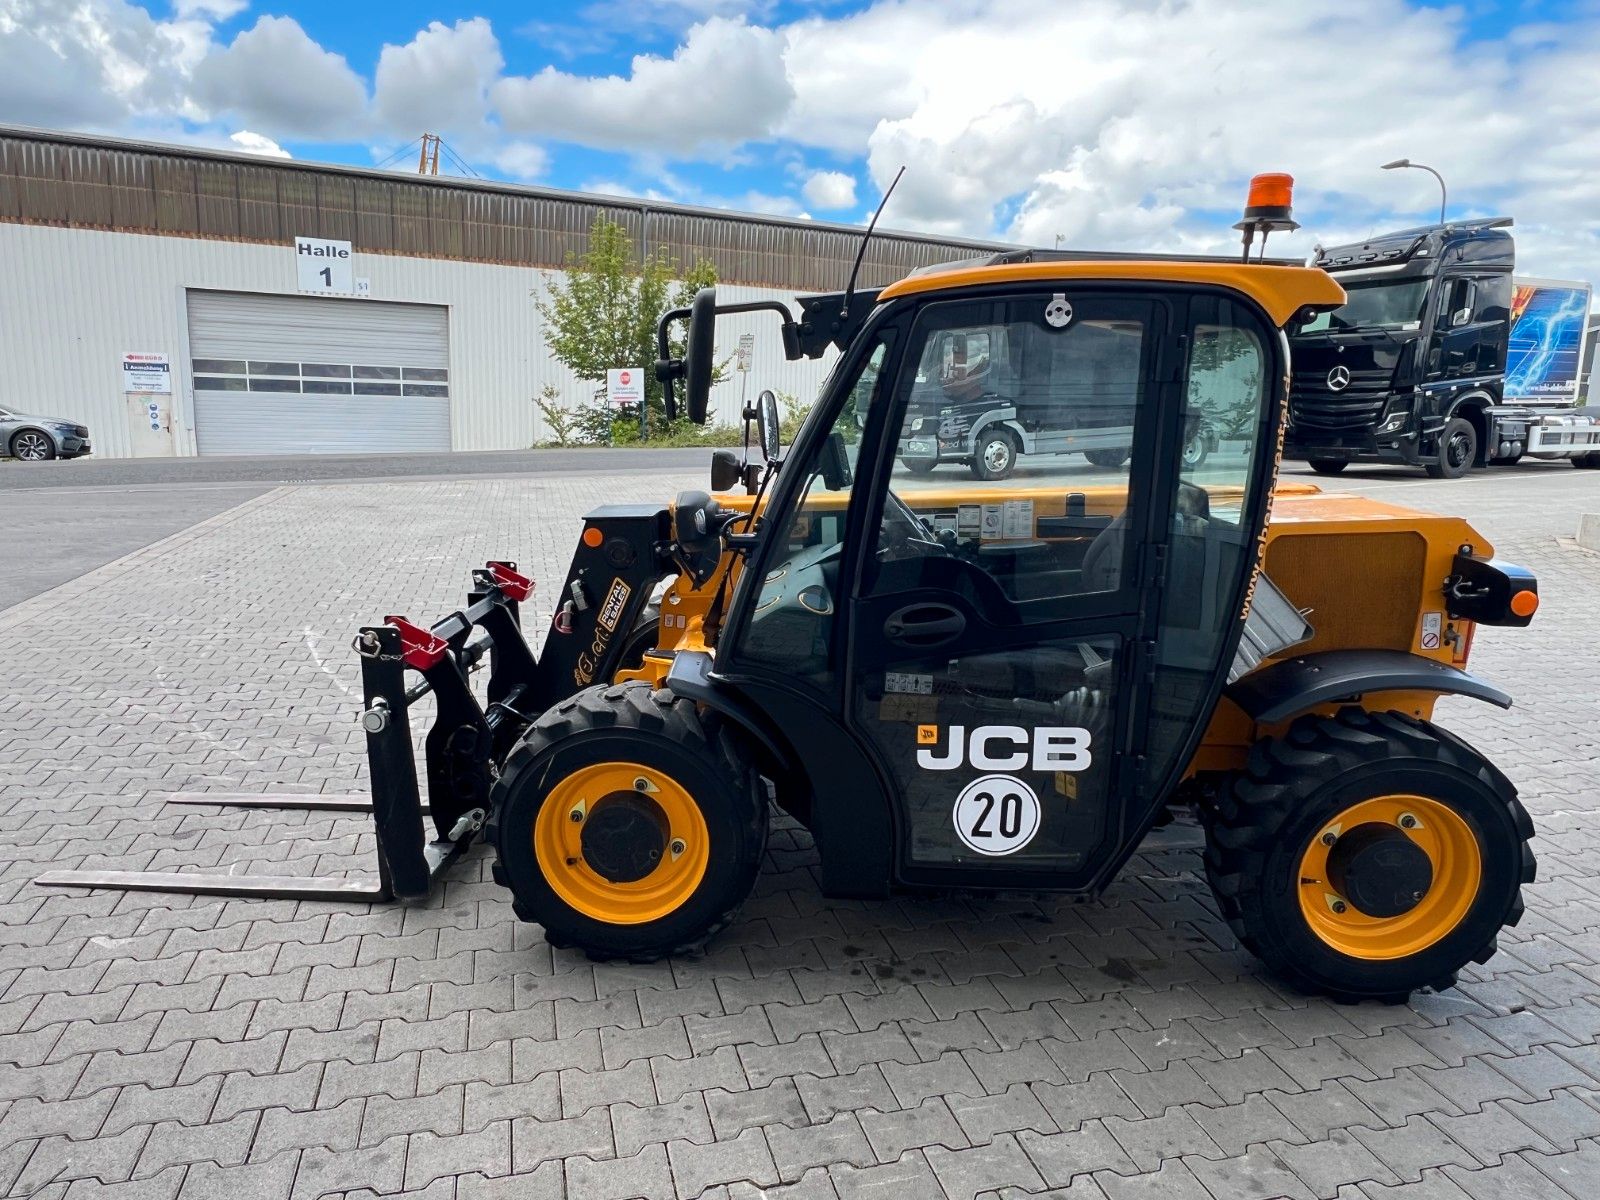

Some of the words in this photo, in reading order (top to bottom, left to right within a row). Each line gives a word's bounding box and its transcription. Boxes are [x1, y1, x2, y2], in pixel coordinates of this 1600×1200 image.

[298, 243, 349, 259] Halle
[319, 267, 332, 287] 1
[601, 585, 622, 623] RENTAL
[610, 587, 627, 619] SALES
[916, 725, 1092, 772] JCB
[971, 791, 1023, 839] 20
